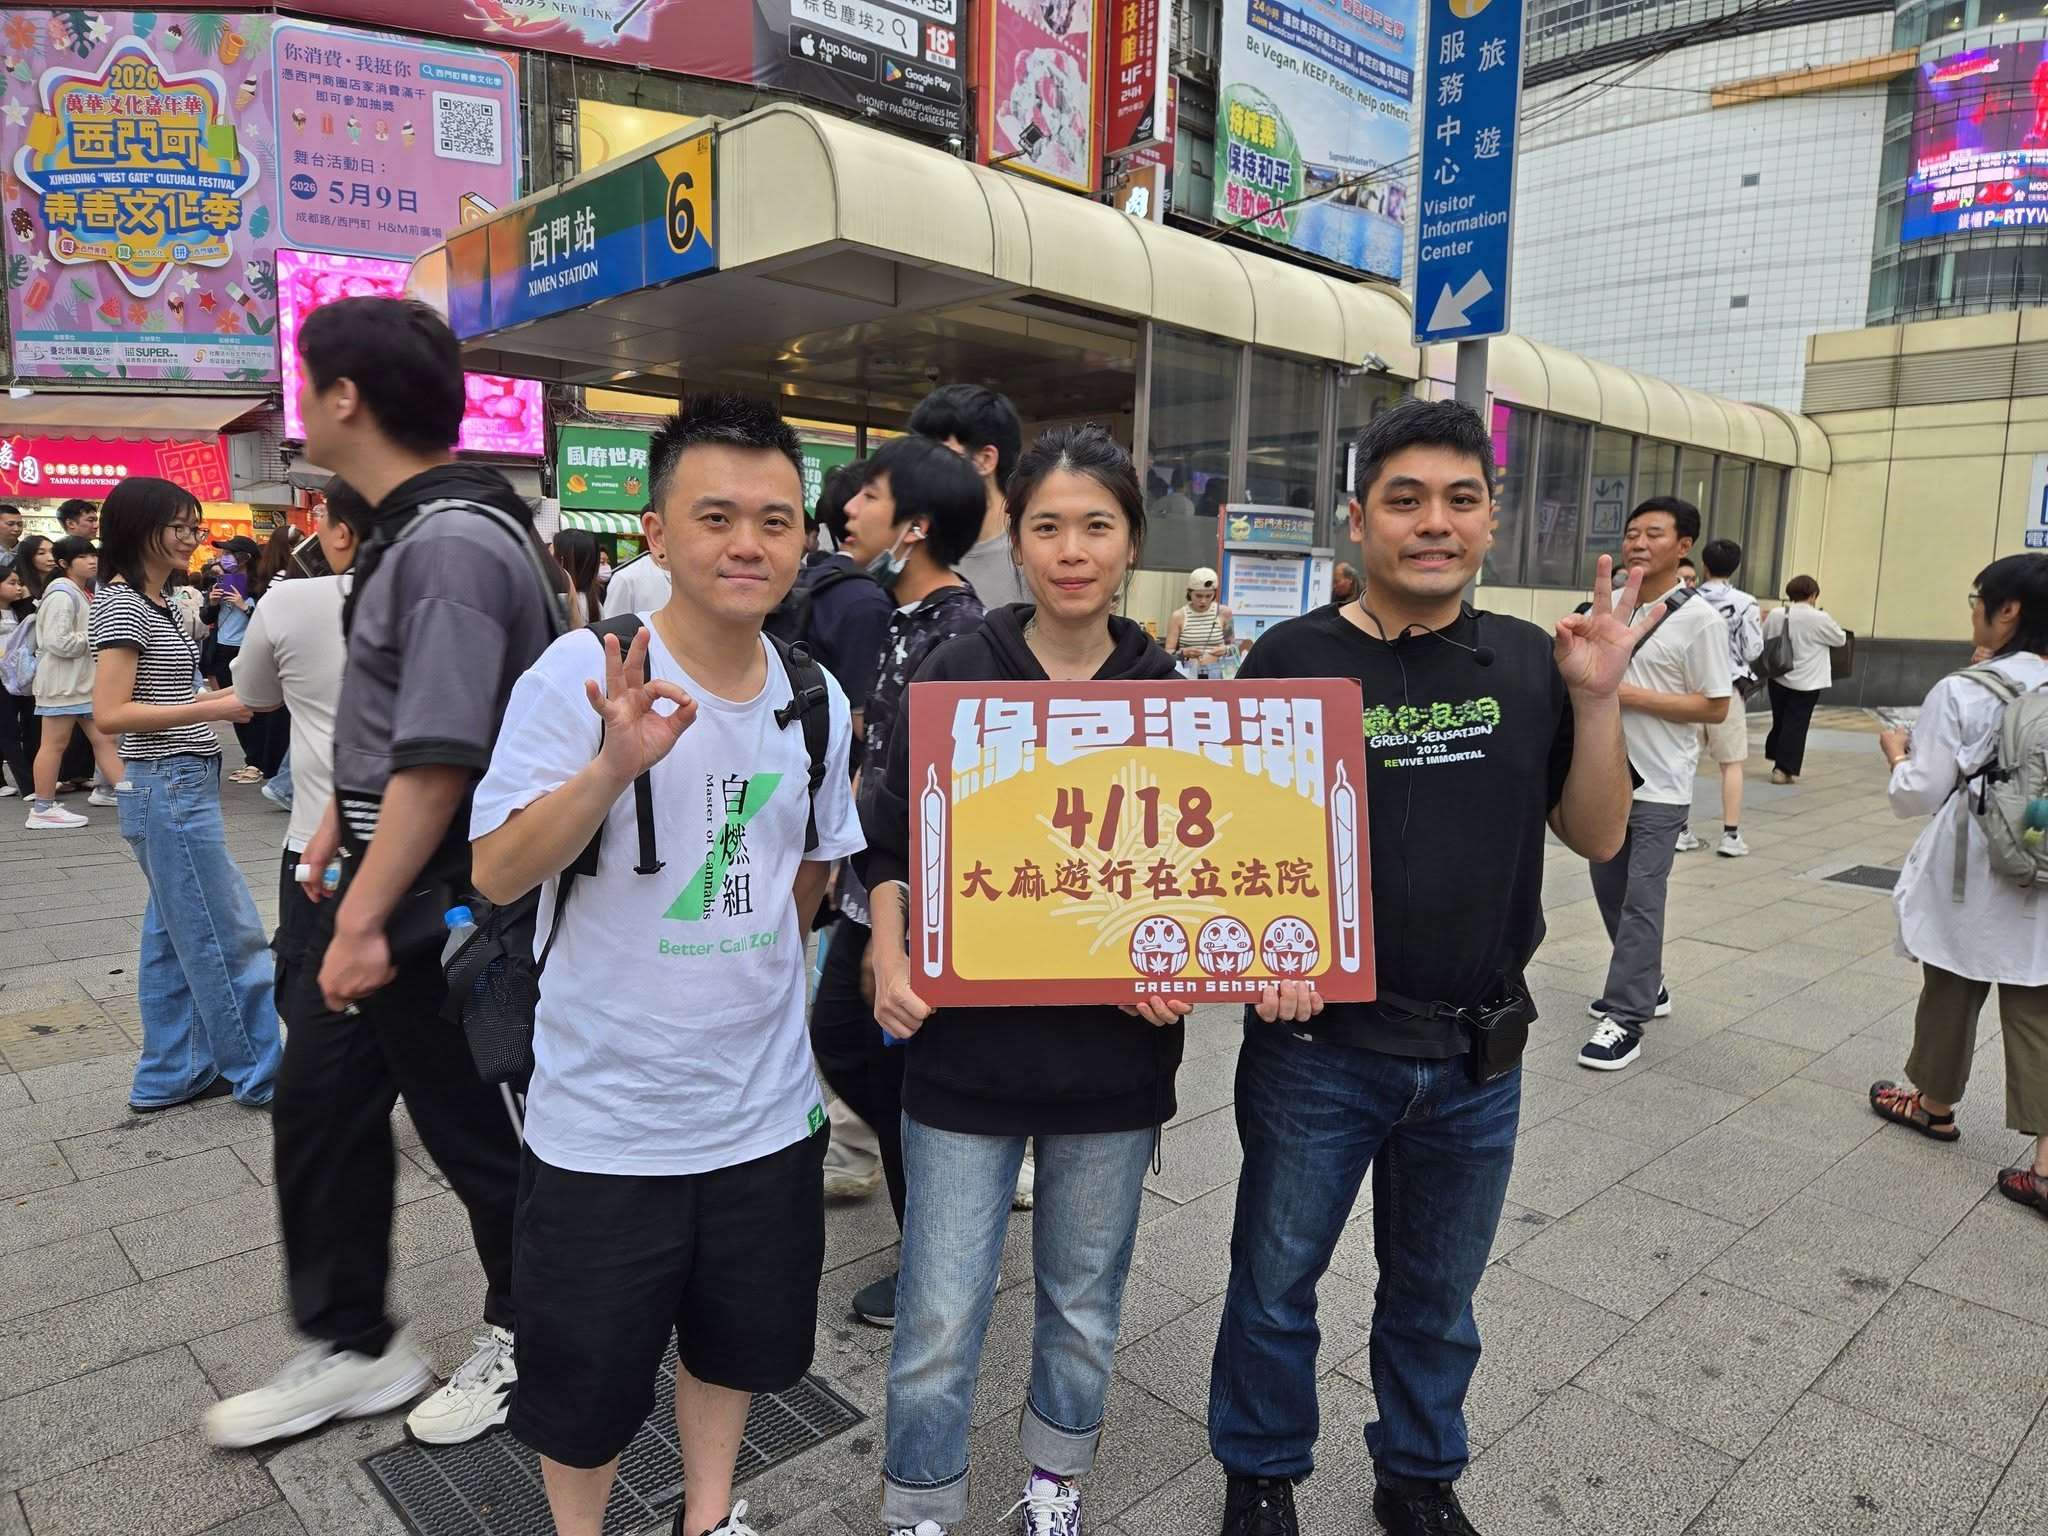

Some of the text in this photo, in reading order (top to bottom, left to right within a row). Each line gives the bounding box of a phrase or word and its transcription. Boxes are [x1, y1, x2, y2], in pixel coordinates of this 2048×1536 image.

[551, 1, 577, 14] NEW
[583, 7, 612, 21] LINK
[1120, 0, 1138, 66] 技館
[819, 38, 868, 65] App Store
[110, 64, 160, 90] 2026
[281, 67, 427, 100] 憑西門商圈店家消費滿千
[904, 67, 951, 93] Google Play
[1121, 64, 1143, 85] 4F
[1246, 34, 1260, 55] Be
[1262, 42, 1300, 75] Vegan,
[1302, 60, 1328, 84] KEEP
[1329, 74, 1356, 101] Peace,
[1357, 88, 1378, 112] help
[65, 94, 205, 116] 萬華文化嘉年華
[315, 90, 396, 113] 即可參加抽獎
[1120, 85, 1142, 102] 24H
[1473, 37, 1507, 161] 旅遊
[889, 103, 917, 120] PARADE
[918, 112, 945, 127] GAMES
[945, 118, 960, 130] Inc.
[945, 108, 960, 120] Inc.
[1434, 29, 1465, 186] 服務中心
[71, 120, 201, 169] 西門町
[1226, 142, 1291, 193] 保持和平
[49, 173, 96, 186] XIMENDING
[156, 173, 197, 187] CULTURAL
[199, 176, 236, 191] FESTIVAL
[291, 180, 317, 194] 2026
[43, 190, 242, 230] 青春文化季
[328, 180, 419, 214] 5月9日
[1225, 181, 1288, 231] 幫助他人
[1423, 192, 1476, 217] Visitor
[295, 212, 442, 239] 成都路/西門町 H&M前廣場
[666, 171, 697, 253] 6
[1421, 208, 1508, 240] Information
[528, 206, 598, 271] 西門站
[1421, 239, 1474, 262] Center
[528, 260, 599, 297] XIMEN STATION
[50, 477, 80, 485] TAIWAN
[1369, 723, 1493, 749] GREEN SENSATION
[1416, 744, 1448, 755] 2022
[951, 697, 1326, 808] 綠色浪潮
[1384, 750, 1486, 768] REVIVE IMMORTAL
[1051, 783, 1216, 852] 4/18
[702, 773, 716, 920] Master of Cannabis
[719, 773, 754, 918] 自燃組
[959, 856, 1322, 902] 大麻遊行在立法院
[658, 937, 715, 956] Better
[719, 936, 748, 953] Call
[1134, 979, 1316, 992] GREEN SENSATN
